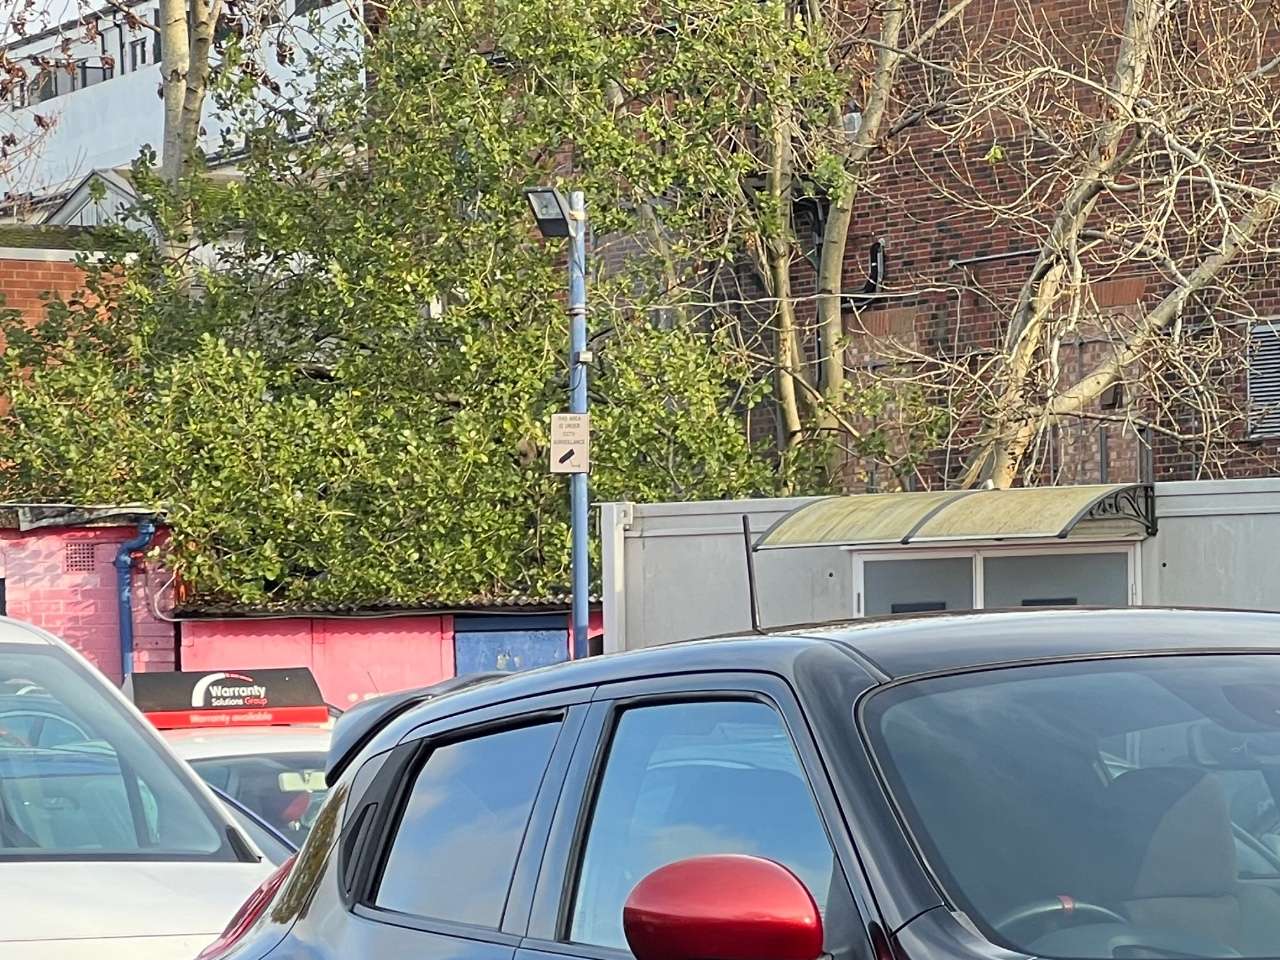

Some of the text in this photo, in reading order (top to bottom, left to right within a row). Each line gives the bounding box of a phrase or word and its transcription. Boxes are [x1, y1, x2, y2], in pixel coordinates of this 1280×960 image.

[209, 685, 267, 698] Warranty
[212, 697, 268, 706] Solutions Group
[189, 712, 273, 724] Warranty available
